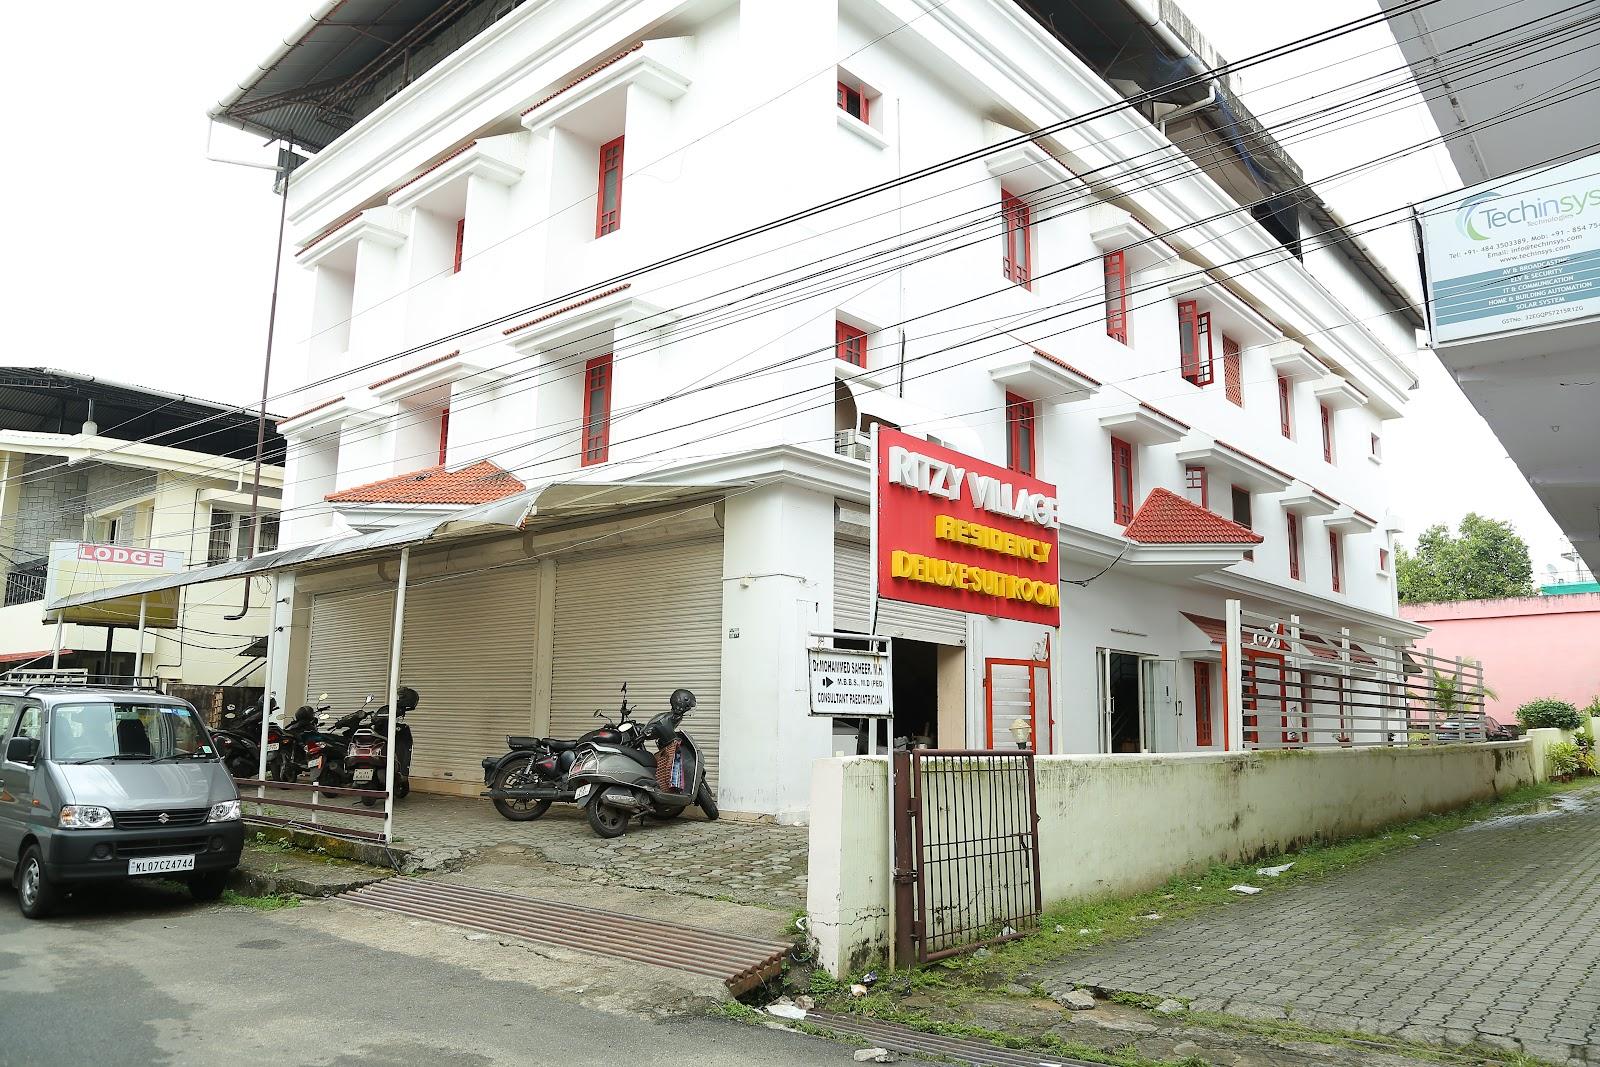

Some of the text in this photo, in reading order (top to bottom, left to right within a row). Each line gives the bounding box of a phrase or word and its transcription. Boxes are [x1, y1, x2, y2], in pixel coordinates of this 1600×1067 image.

[1479, 189, 1600, 229] Techinsys
[1488, 250, 1509, 259] Email:
[1500, 244, 1571, 263] www.techinsys.com
[1518, 275, 1574, 290] COMMUNICATION
[1531, 268, 1563, 279] SECURITY
[1515, 289, 1547, 301] BUILDING
[1547, 281, 1592, 295] AUTOMATION
[1516, 296, 1565, 310] SOLAR SYSTEM
[889, 446, 1060, 530] RITZY VILLAGE
[935, 514, 1052, 563] RESIDENCY
[80, 546, 163, 566] LODGE
[892, 550, 969, 589] DELUXE
[1006, 574, 1059, 607] ROOM
[817, 692, 882, 705] CONSULTANT PAEDIATRICIAN
[136, 858, 193, 872] KL07CZ4744
